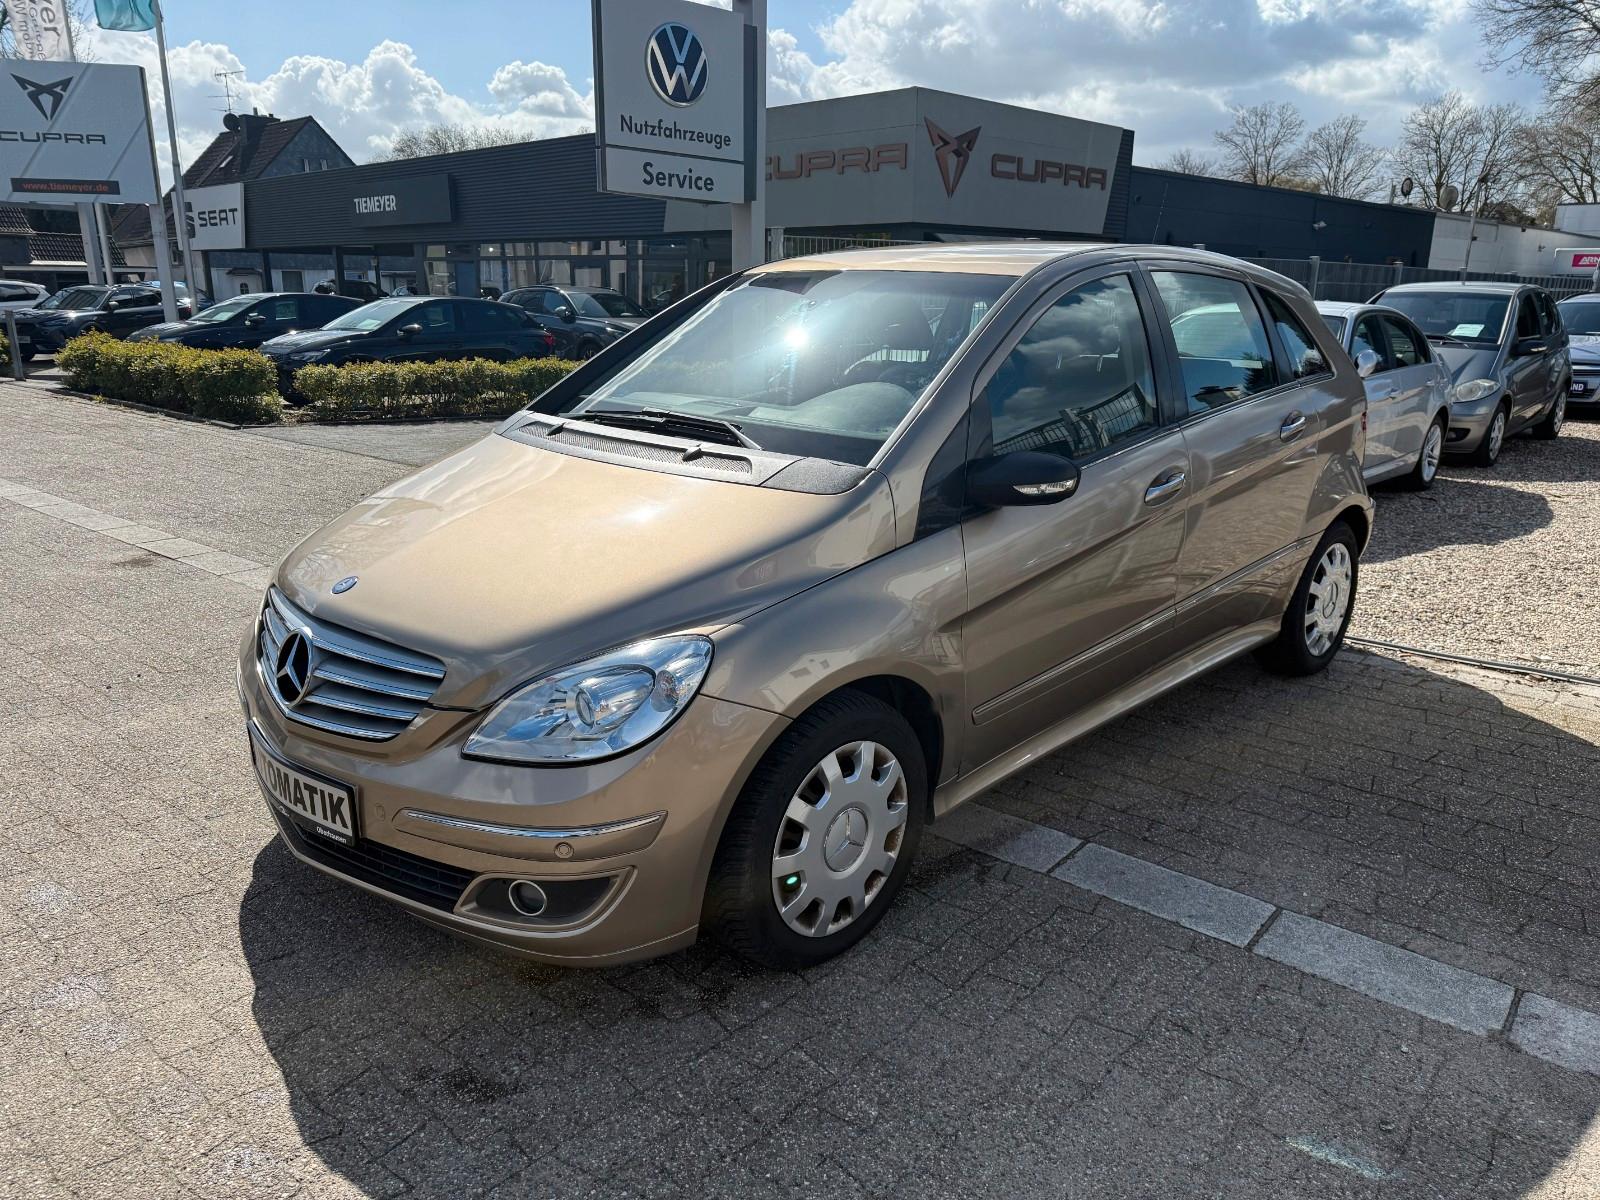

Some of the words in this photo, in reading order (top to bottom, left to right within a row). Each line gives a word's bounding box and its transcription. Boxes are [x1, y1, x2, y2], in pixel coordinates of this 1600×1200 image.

[0, 131, 106, 145] CUPRA
[620, 114, 731, 149] Nutzfahrzeuge
[642, 161, 714, 192] Service
[765, 143, 907, 182] UPRA
[991, 153, 1107, 191] CUPRA
[197, 208, 238, 227] SEAT
[353, 195, 396, 214] TIEMEYER
